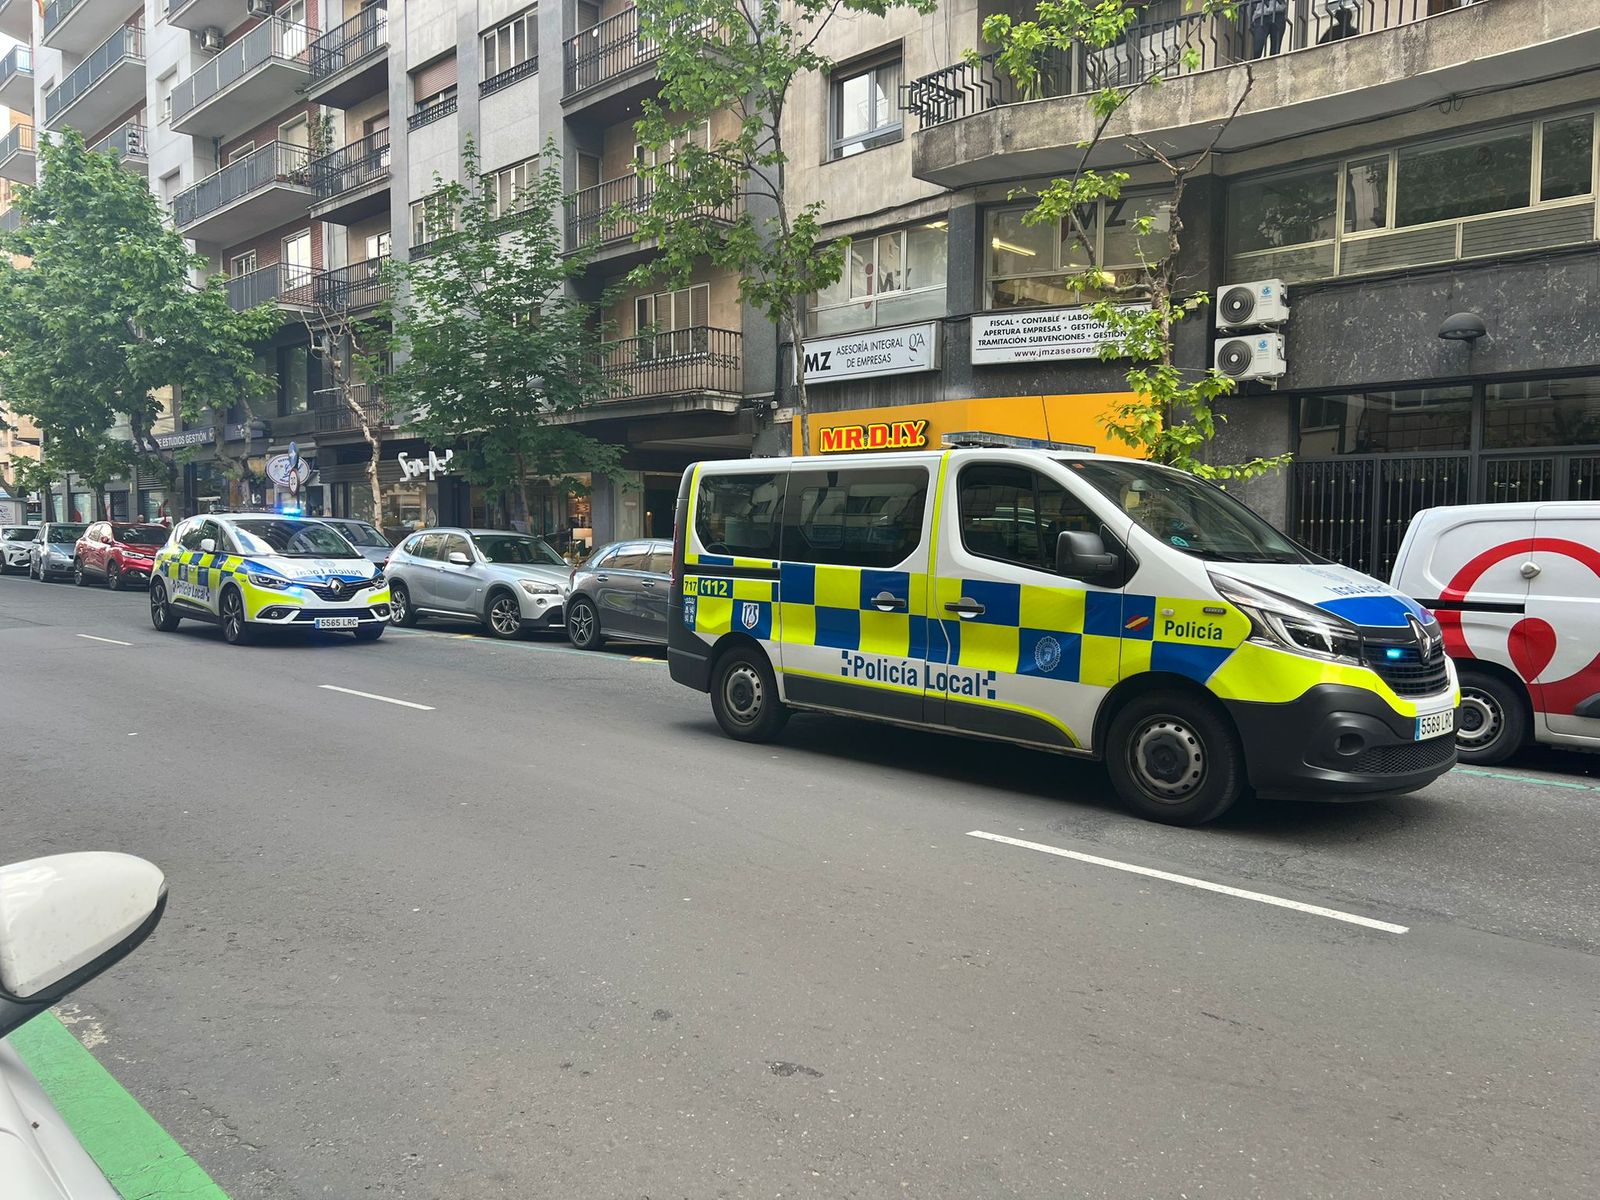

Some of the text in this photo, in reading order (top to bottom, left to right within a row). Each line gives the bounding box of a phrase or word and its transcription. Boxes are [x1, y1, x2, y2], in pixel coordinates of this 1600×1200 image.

[1021, 315, 1060, 324] CONTABLE
[983, 328, 1021, 336] APERTURA
[1023, 325, 1062, 334] EMPRESAS
[978, 335, 1027, 346] TRAMITACIÓN
[1028, 332, 1085, 343] SUBVENCIONES
[836, 337, 903, 356] ASESORÍA INTEGRAL
[846, 353, 892, 368] DE EMPRESAS
[162, 435, 185, 447] ESTUDIOS
[684, 581, 697, 592] 717
[342, 618, 357, 627] LRC
[1164, 620, 1223, 640] Policía
[853, 655, 980, 697] Policía Local
[1421, 715, 1441, 735] 5569
